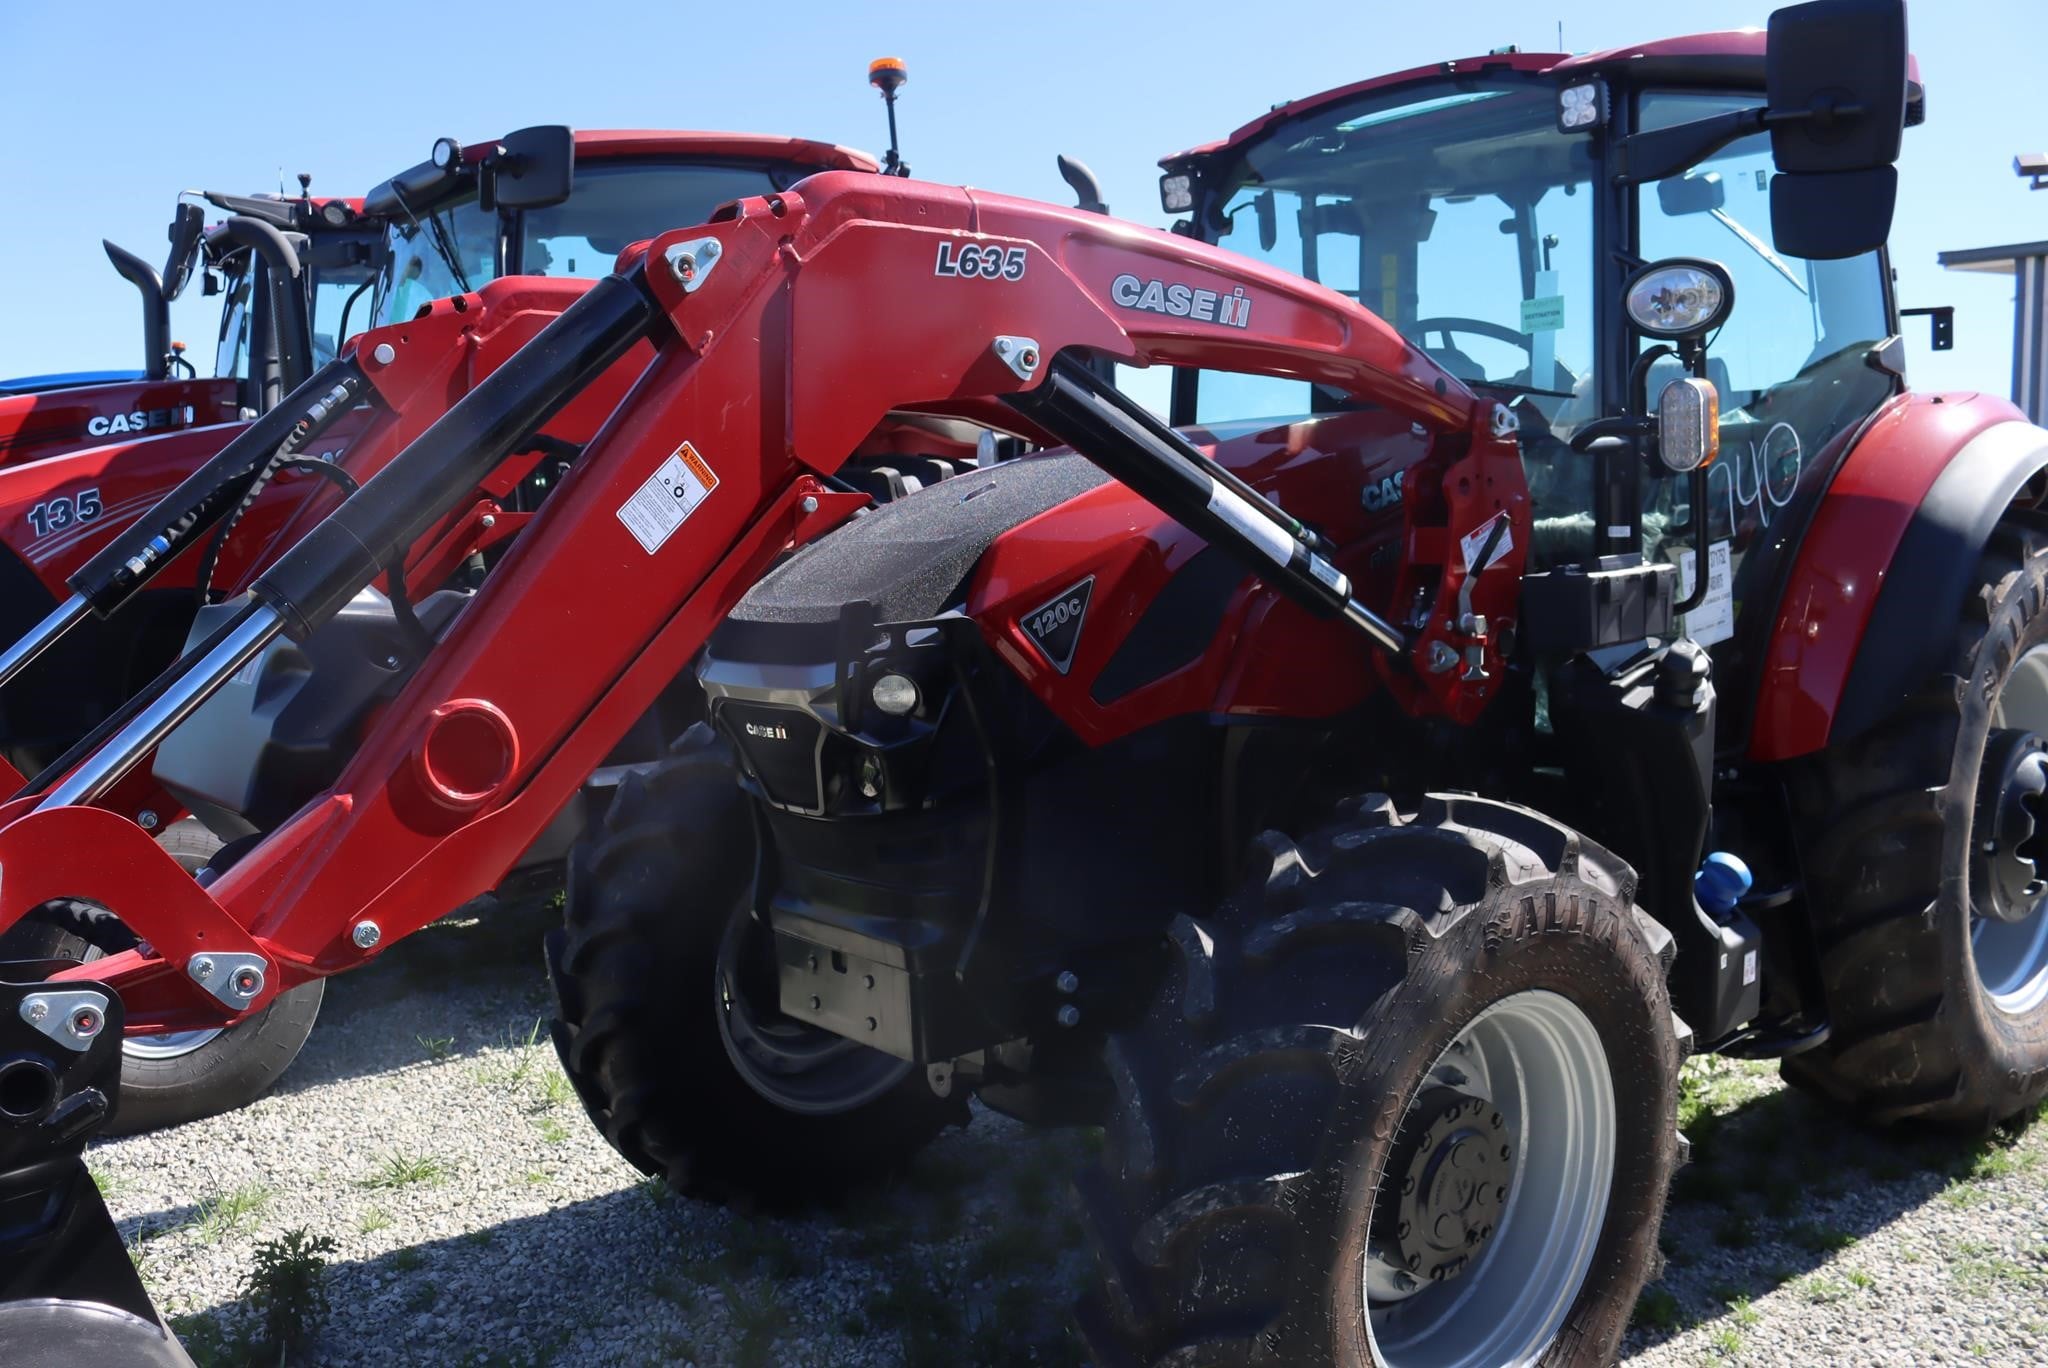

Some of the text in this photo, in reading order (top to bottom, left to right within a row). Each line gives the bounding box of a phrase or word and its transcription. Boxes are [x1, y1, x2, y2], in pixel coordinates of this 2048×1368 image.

[935, 241, 1027, 282] L635
[1111, 273, 1217, 321] CASE
[87, 410, 166, 437] CASE
[688, 454, 714, 486] WARNING
[27, 487, 104, 538] 135
[746, 722, 775, 738] CASE
